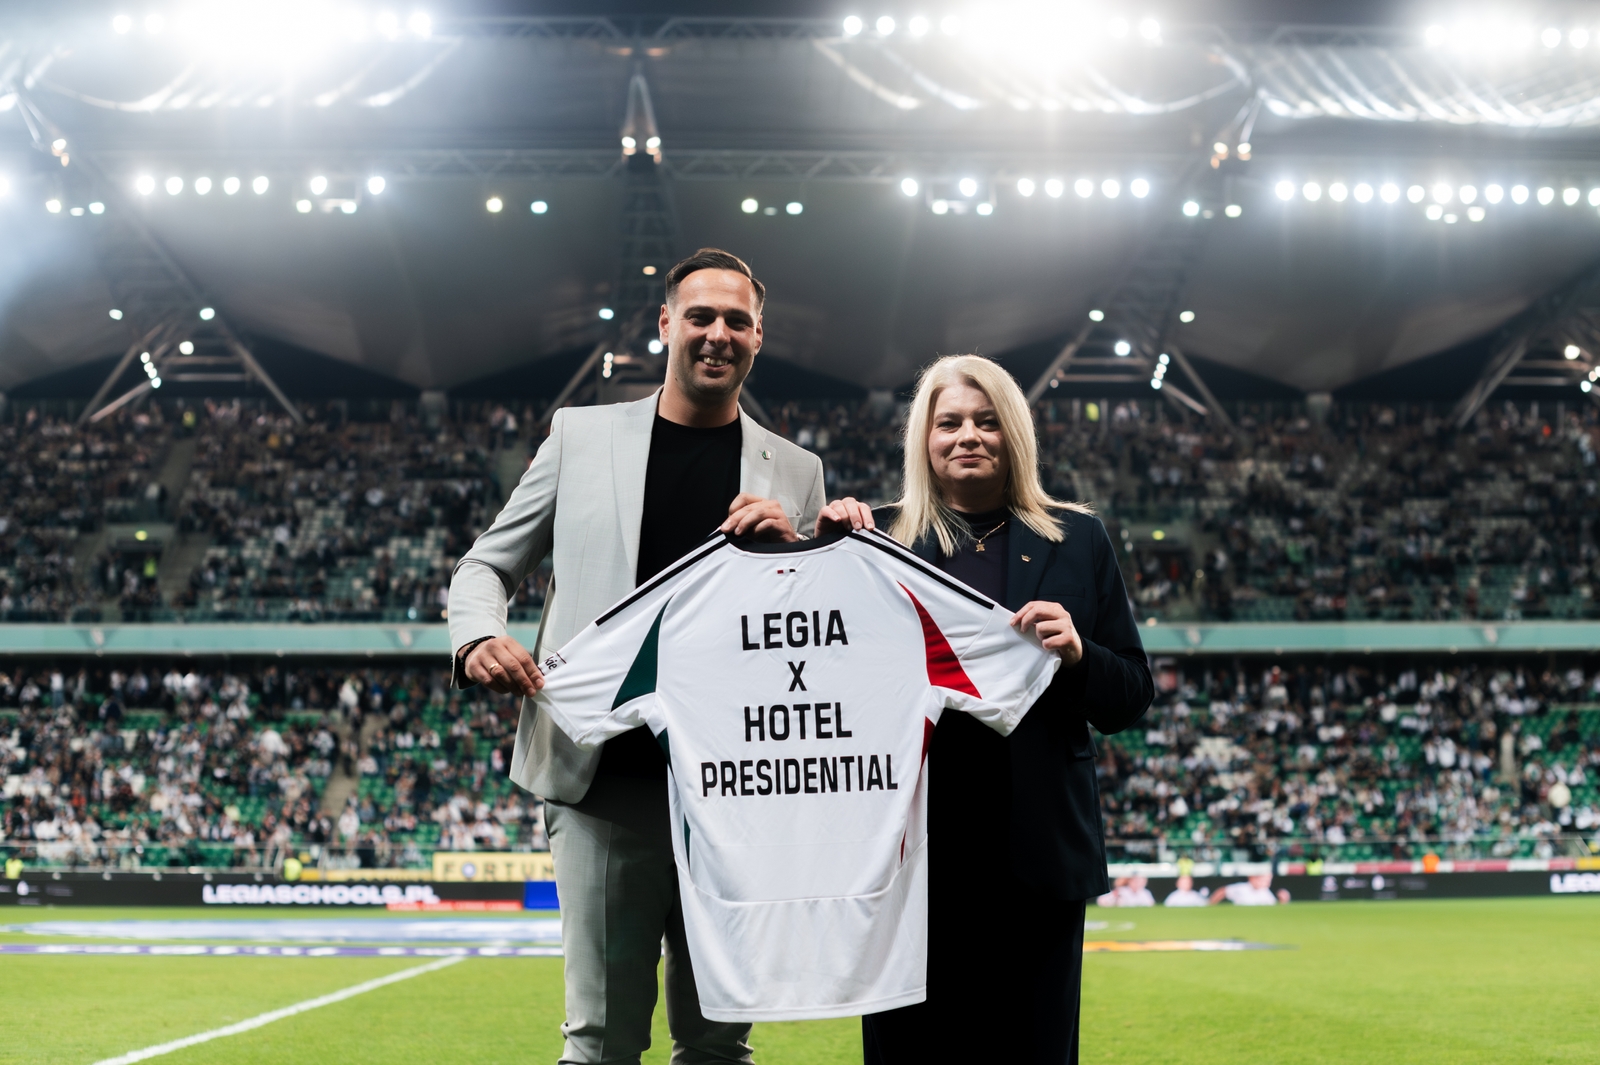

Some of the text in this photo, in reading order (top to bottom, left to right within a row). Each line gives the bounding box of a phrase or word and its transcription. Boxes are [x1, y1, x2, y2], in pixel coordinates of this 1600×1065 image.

[741, 609, 849, 651] LEGIA
[787, 660, 808, 692] X
[744, 702, 853, 742] HOTEL
[701, 754, 899, 798] PRESIDENTIAL
[202, 884, 440, 904] LEGIASCHOOLS.PL
